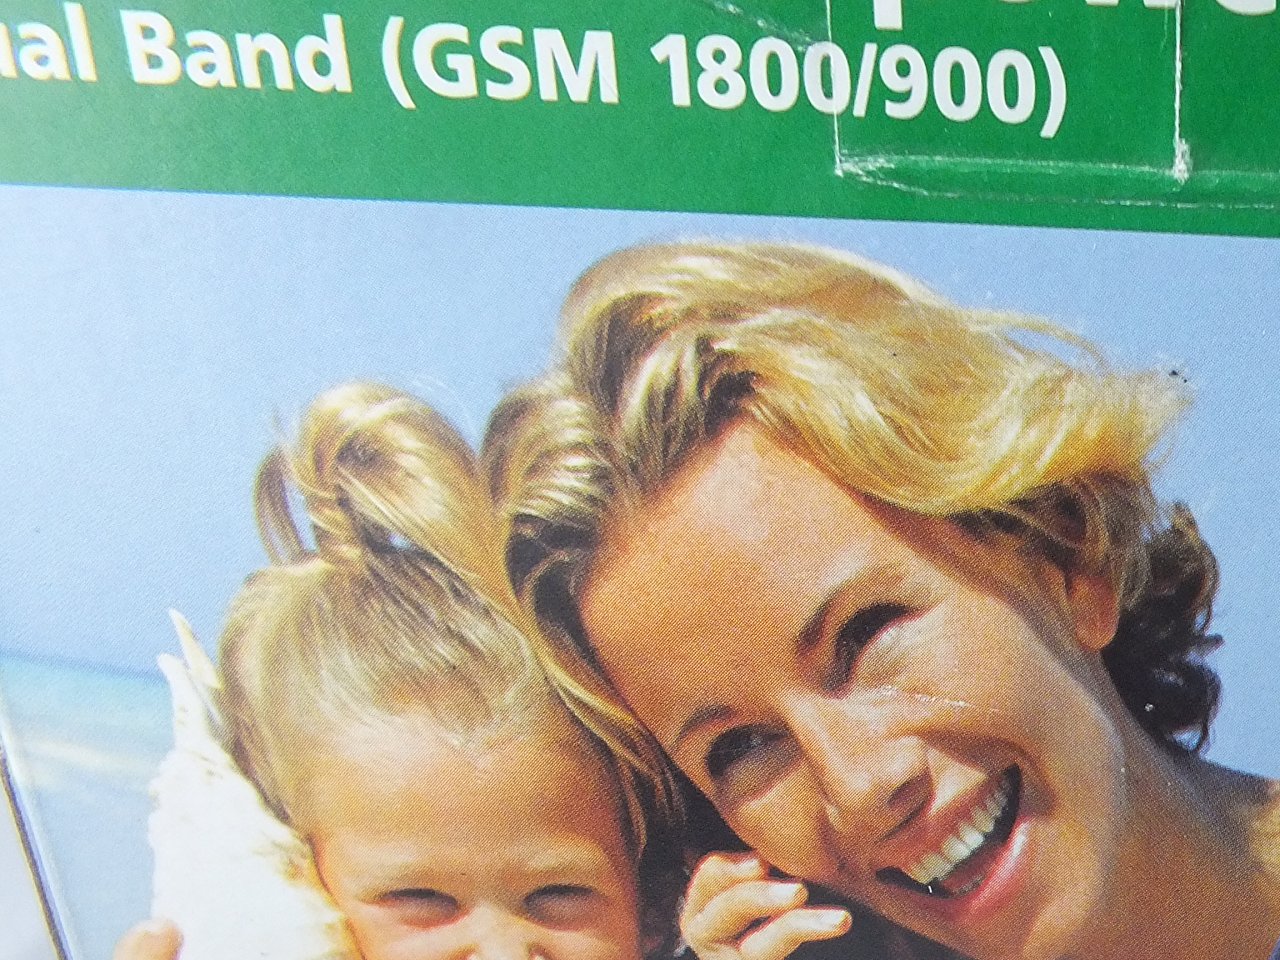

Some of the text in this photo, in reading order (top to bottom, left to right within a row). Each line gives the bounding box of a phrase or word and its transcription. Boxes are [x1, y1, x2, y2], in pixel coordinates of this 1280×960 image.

[119, 9, 352, 94] Band
[383, 17, 619, 109] (GSM
[650, 33, 1067, 138] 1800/900)
